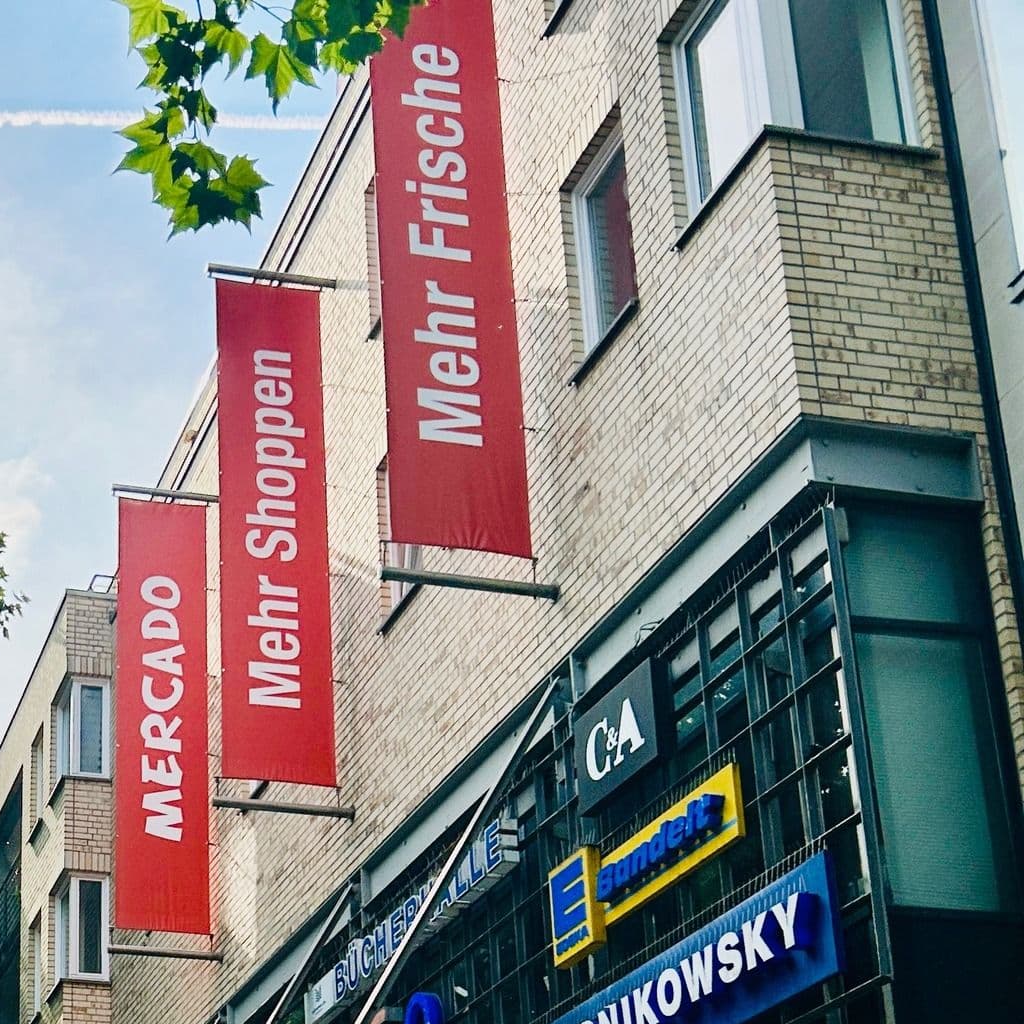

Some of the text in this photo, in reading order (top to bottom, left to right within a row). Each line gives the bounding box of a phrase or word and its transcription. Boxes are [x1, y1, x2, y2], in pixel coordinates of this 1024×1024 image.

[401, 43, 484, 447] Mehr Frische
[245, 349, 306, 709] Mehr Shoppen
[140, 575, 185, 842] MERCADO
[585, 698, 645, 781] C&A
[333, 819, 502, 1002] BÜCHERLLE
